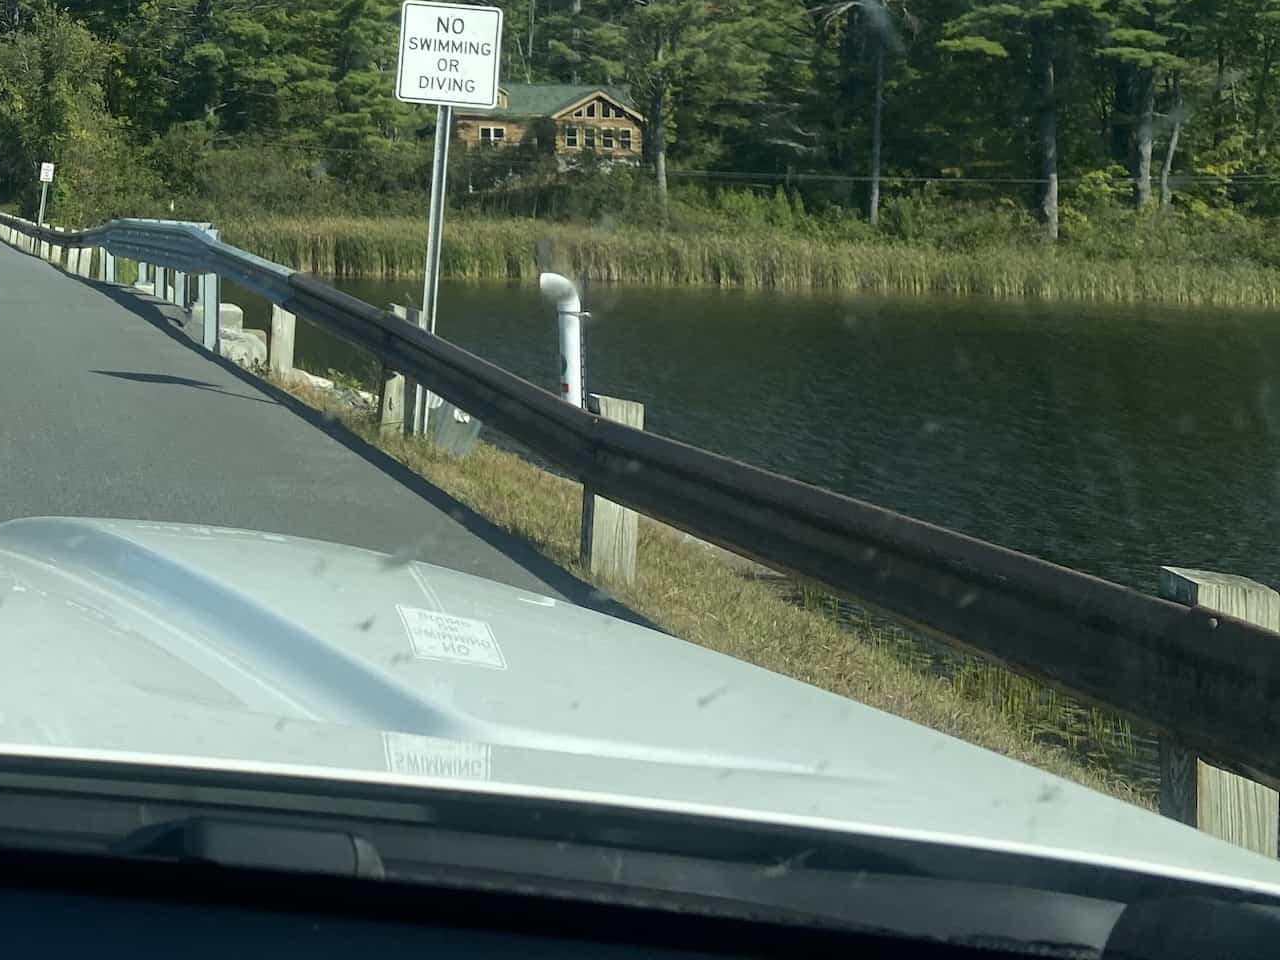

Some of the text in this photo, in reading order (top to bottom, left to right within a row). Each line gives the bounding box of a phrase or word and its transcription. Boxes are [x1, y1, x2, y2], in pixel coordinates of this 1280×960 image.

[436, 16, 465, 35] NO
[408, 36, 492, 57] SWIMMING
[437, 57, 460, 73] OR
[418, 75, 476, 93] DIVING
